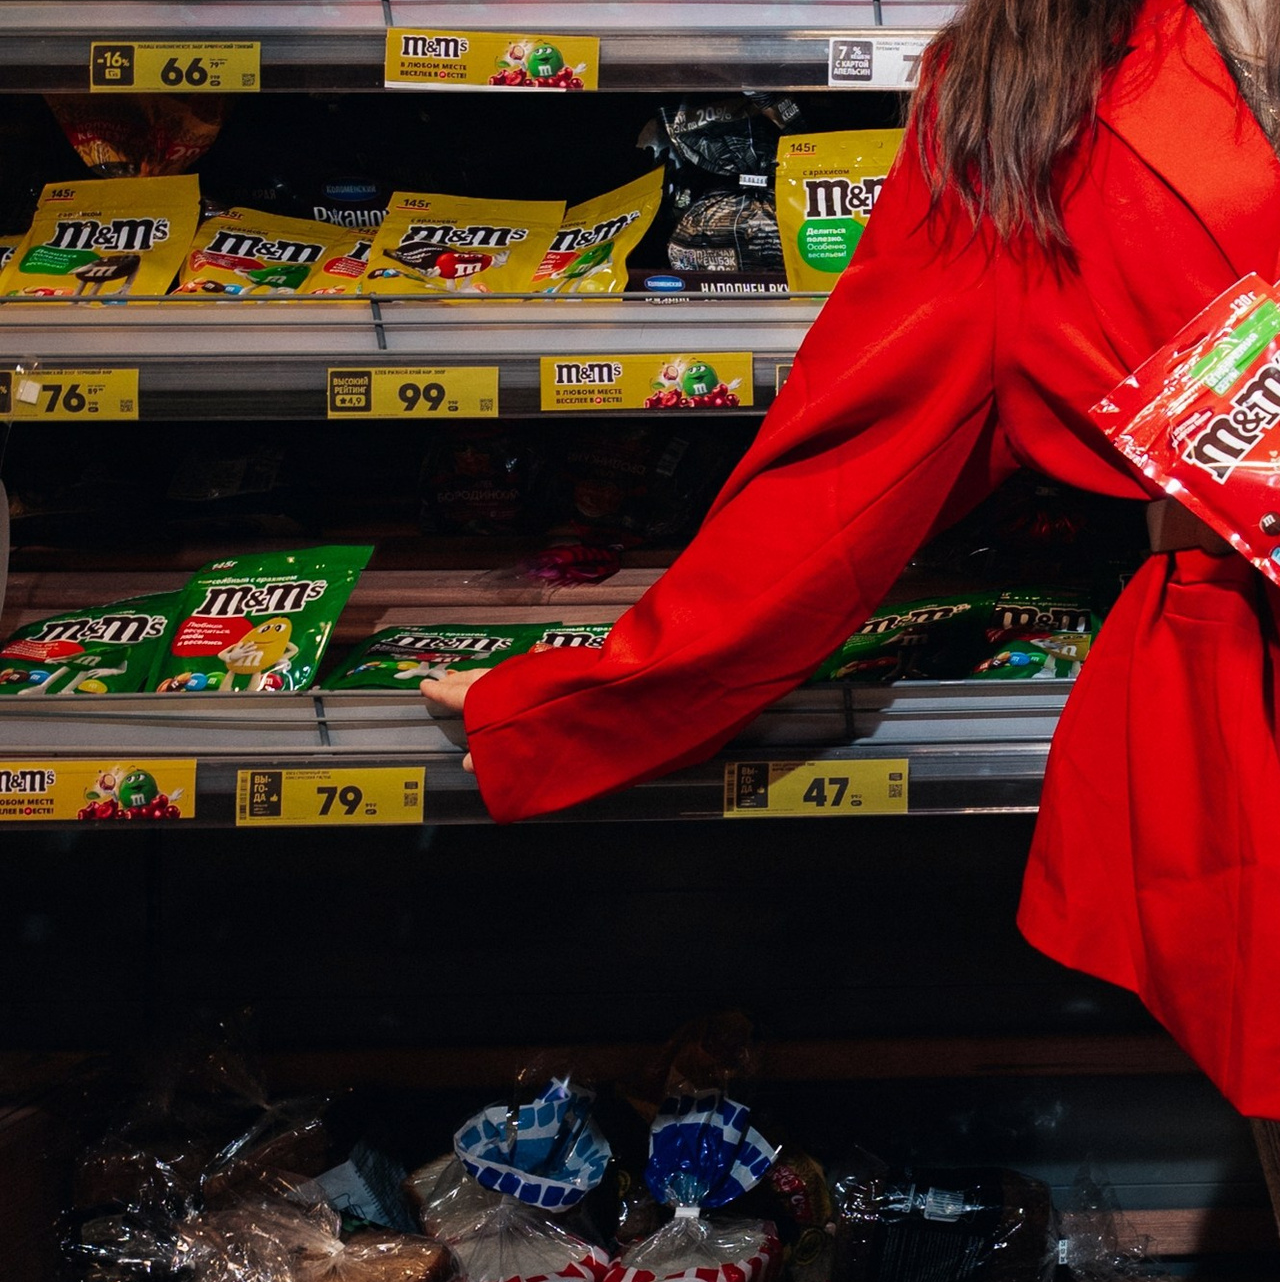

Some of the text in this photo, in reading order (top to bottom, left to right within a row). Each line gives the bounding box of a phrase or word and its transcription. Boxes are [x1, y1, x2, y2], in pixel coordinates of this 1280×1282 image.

[161, 58, 208, 86] 66
[790, 143, 817, 153] 145г
[806, 227, 846, 236] Делиться
[333, 377, 369, 385] ВЫСОКИЙ
[334, 385, 368, 394] РЕЙТИНГ
[42, 384, 86, 412] 76
[398, 383, 446, 411] 99
[316, 785, 363, 816] 79
[802, 777, 849, 807] 47
[27, 798, 54, 806] МЕСТЕ
